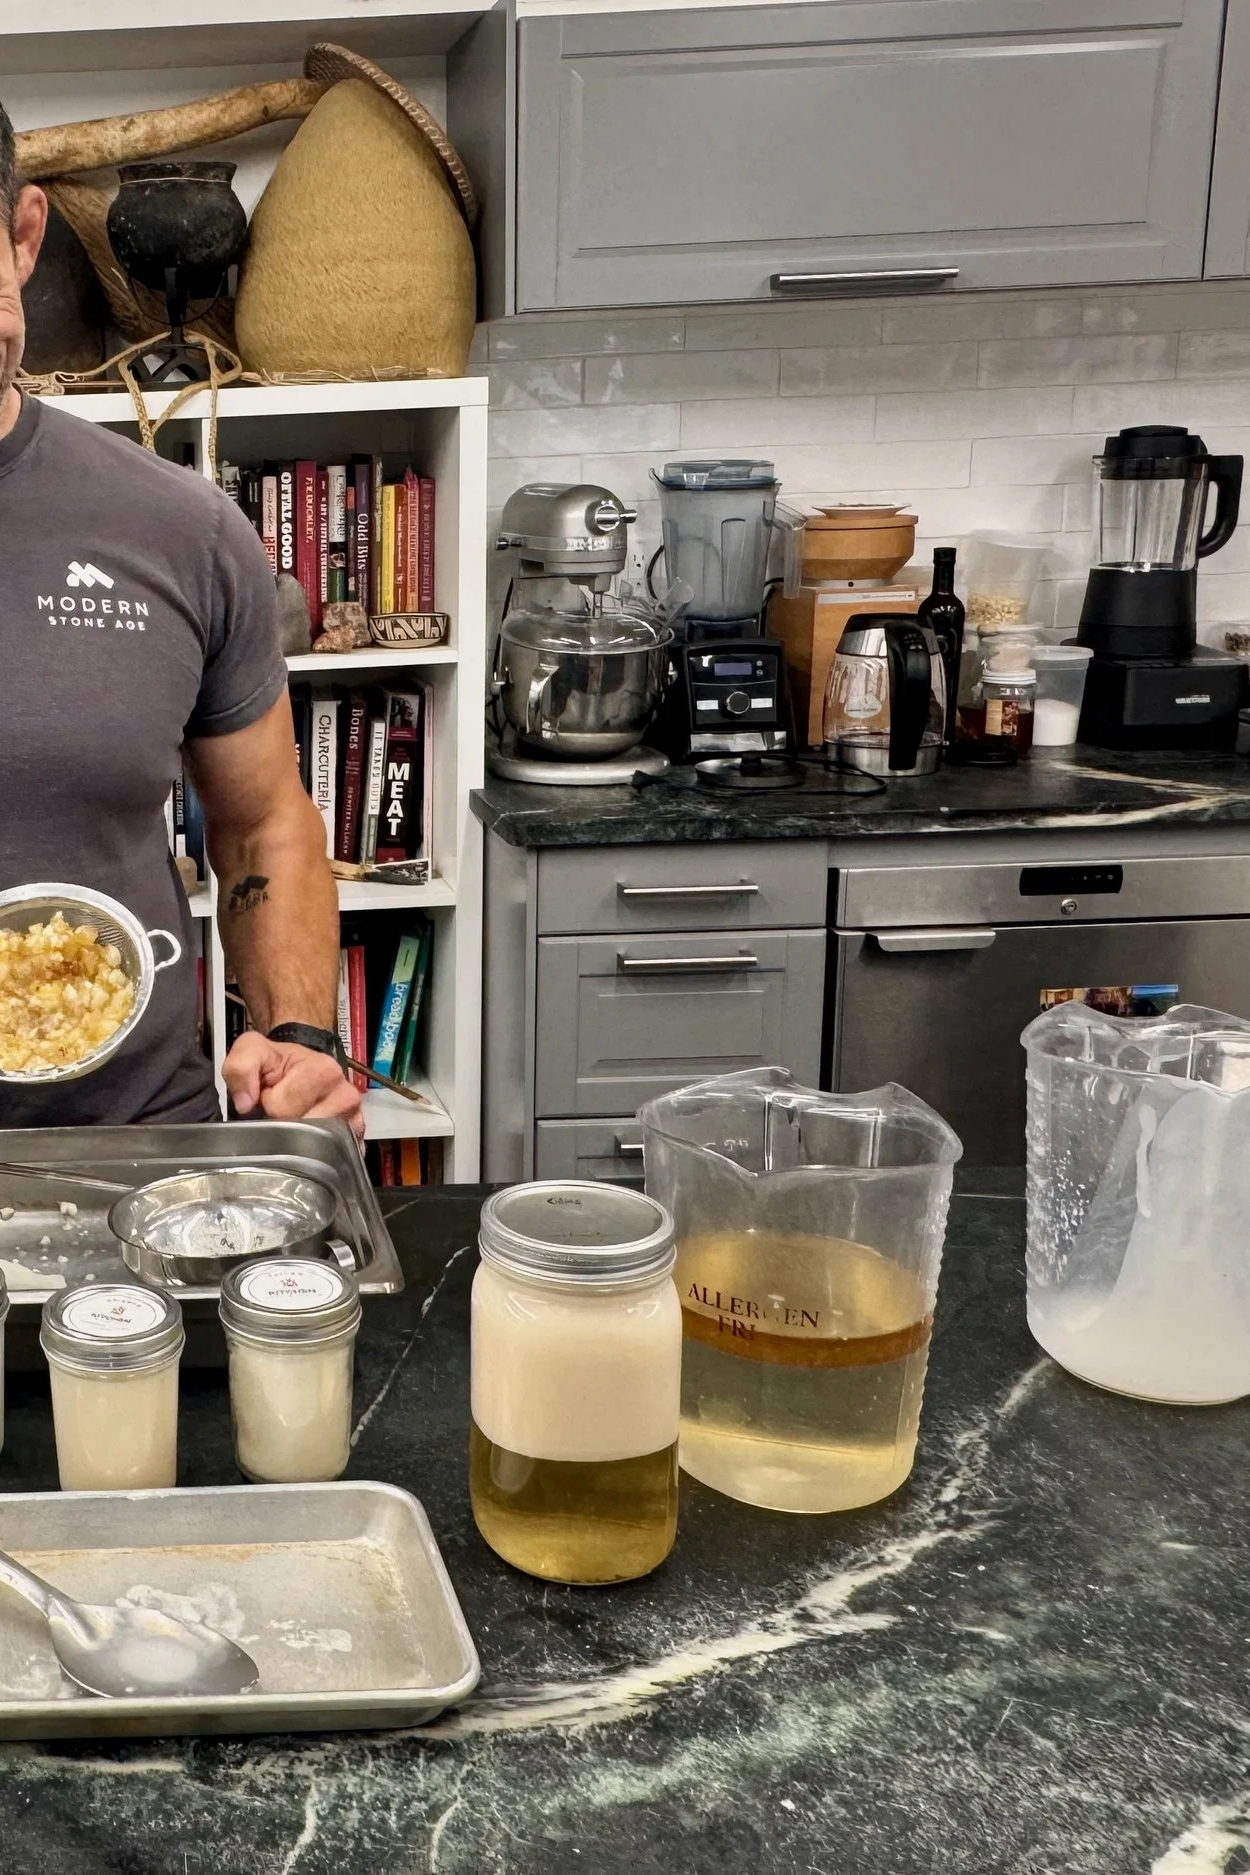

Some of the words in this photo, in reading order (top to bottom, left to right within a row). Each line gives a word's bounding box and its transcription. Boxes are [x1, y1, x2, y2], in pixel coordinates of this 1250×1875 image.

[357, 513, 369, 541] Odd
[281, 522, 293, 569] GOOD
[357, 545, 368, 570] Bits
[37, 595, 150, 616] MODERN
[48, 615, 105, 628] STONE
[349, 708, 364, 750] Bones
[386, 762, 410, 836] MEAT
